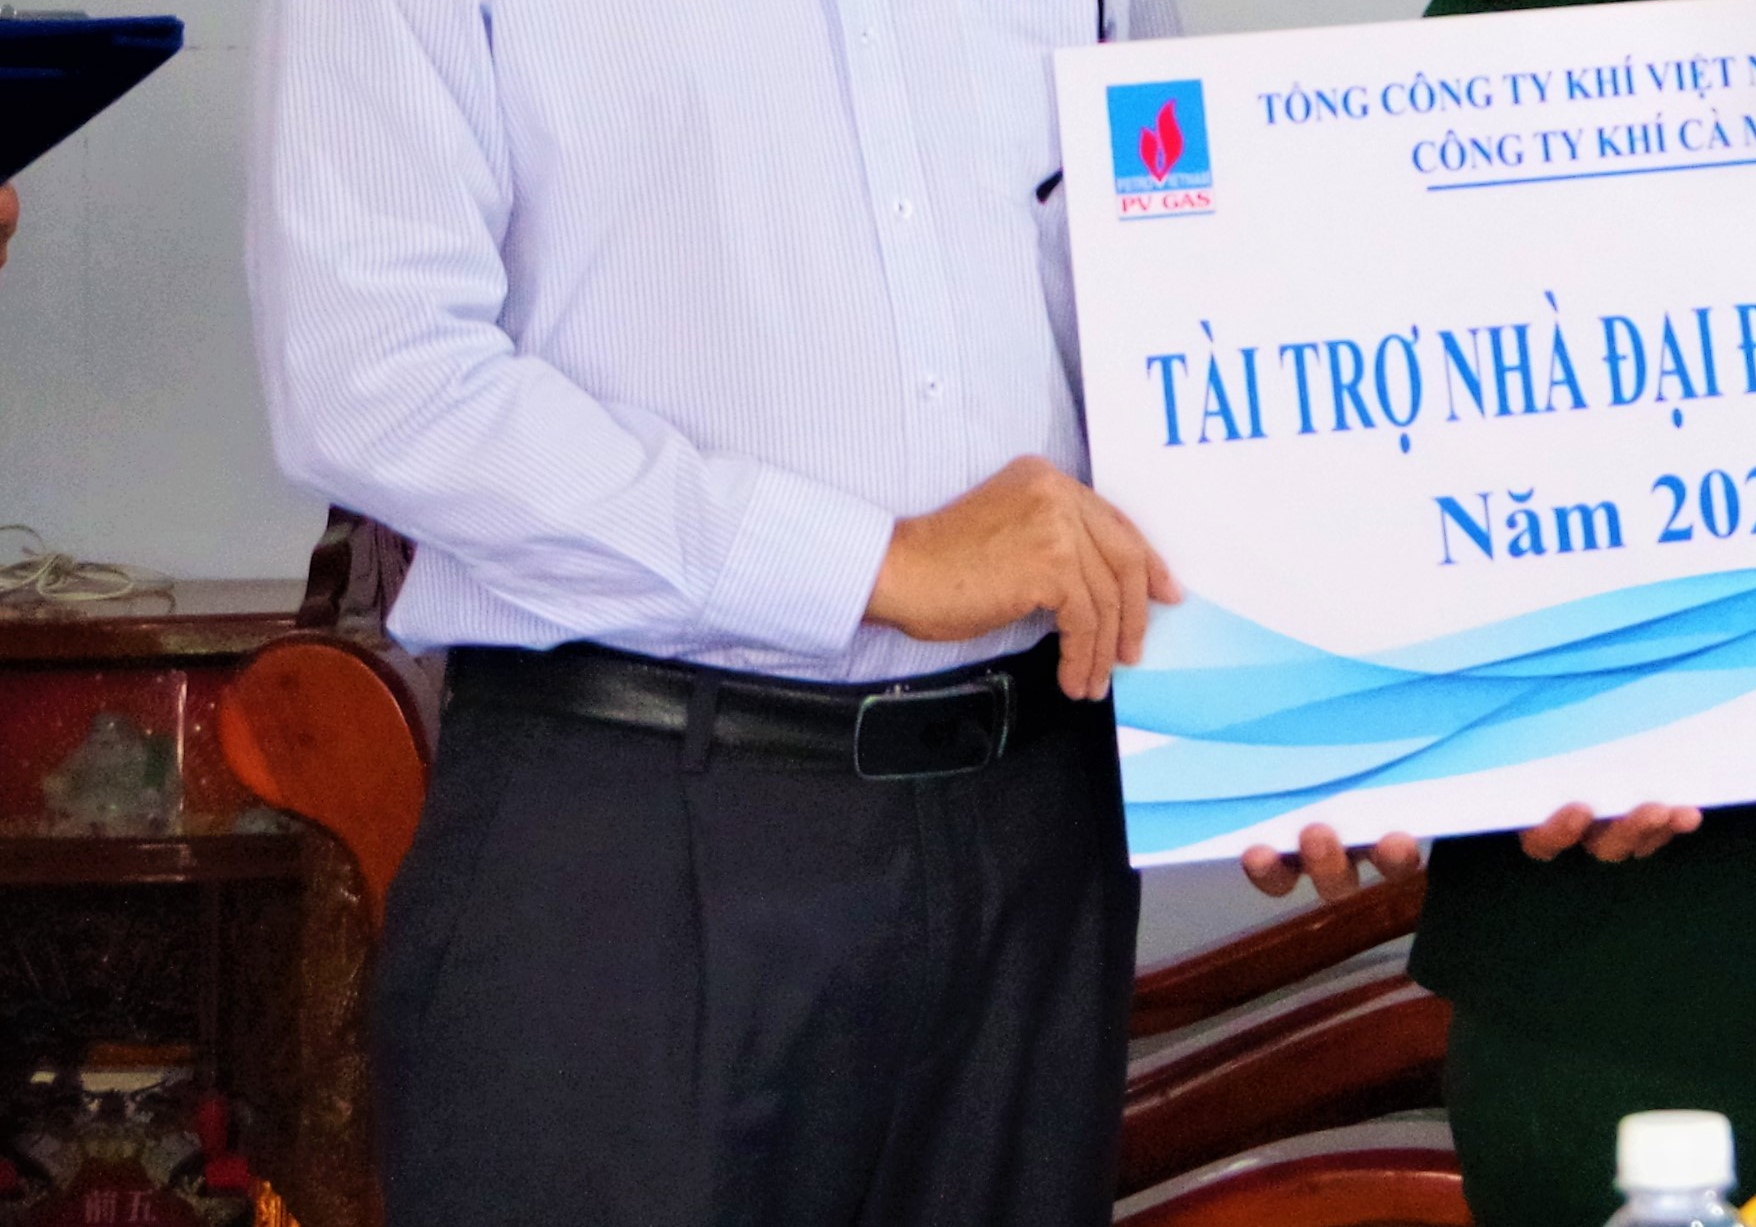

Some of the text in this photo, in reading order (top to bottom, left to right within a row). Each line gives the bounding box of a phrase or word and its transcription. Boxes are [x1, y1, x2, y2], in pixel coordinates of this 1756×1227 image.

[1380, 71, 1493, 115] CÔNG
[1502, 70, 1552, 106] TY
[1566, 55, 1637, 101] KHÍ
[1647, 52, 1736, 100] VIỆT
[1411, 128, 1525, 174] CÔNG
[1533, 127, 1585, 165] TY
[1596, 111, 1668, 159] KHÍ
[1678, 107, 1731, 151] CÀ
[1121, 190, 1212, 213] PV GAS
[1146, 319, 1269, 447] TÀI
[1279, 323, 1424, 455] TRỢ
[1437, 289, 1589, 422] NHÀ
[1598, 307, 1724, 429] ĐẠI
[1433, 486, 1626, 566] Năm
